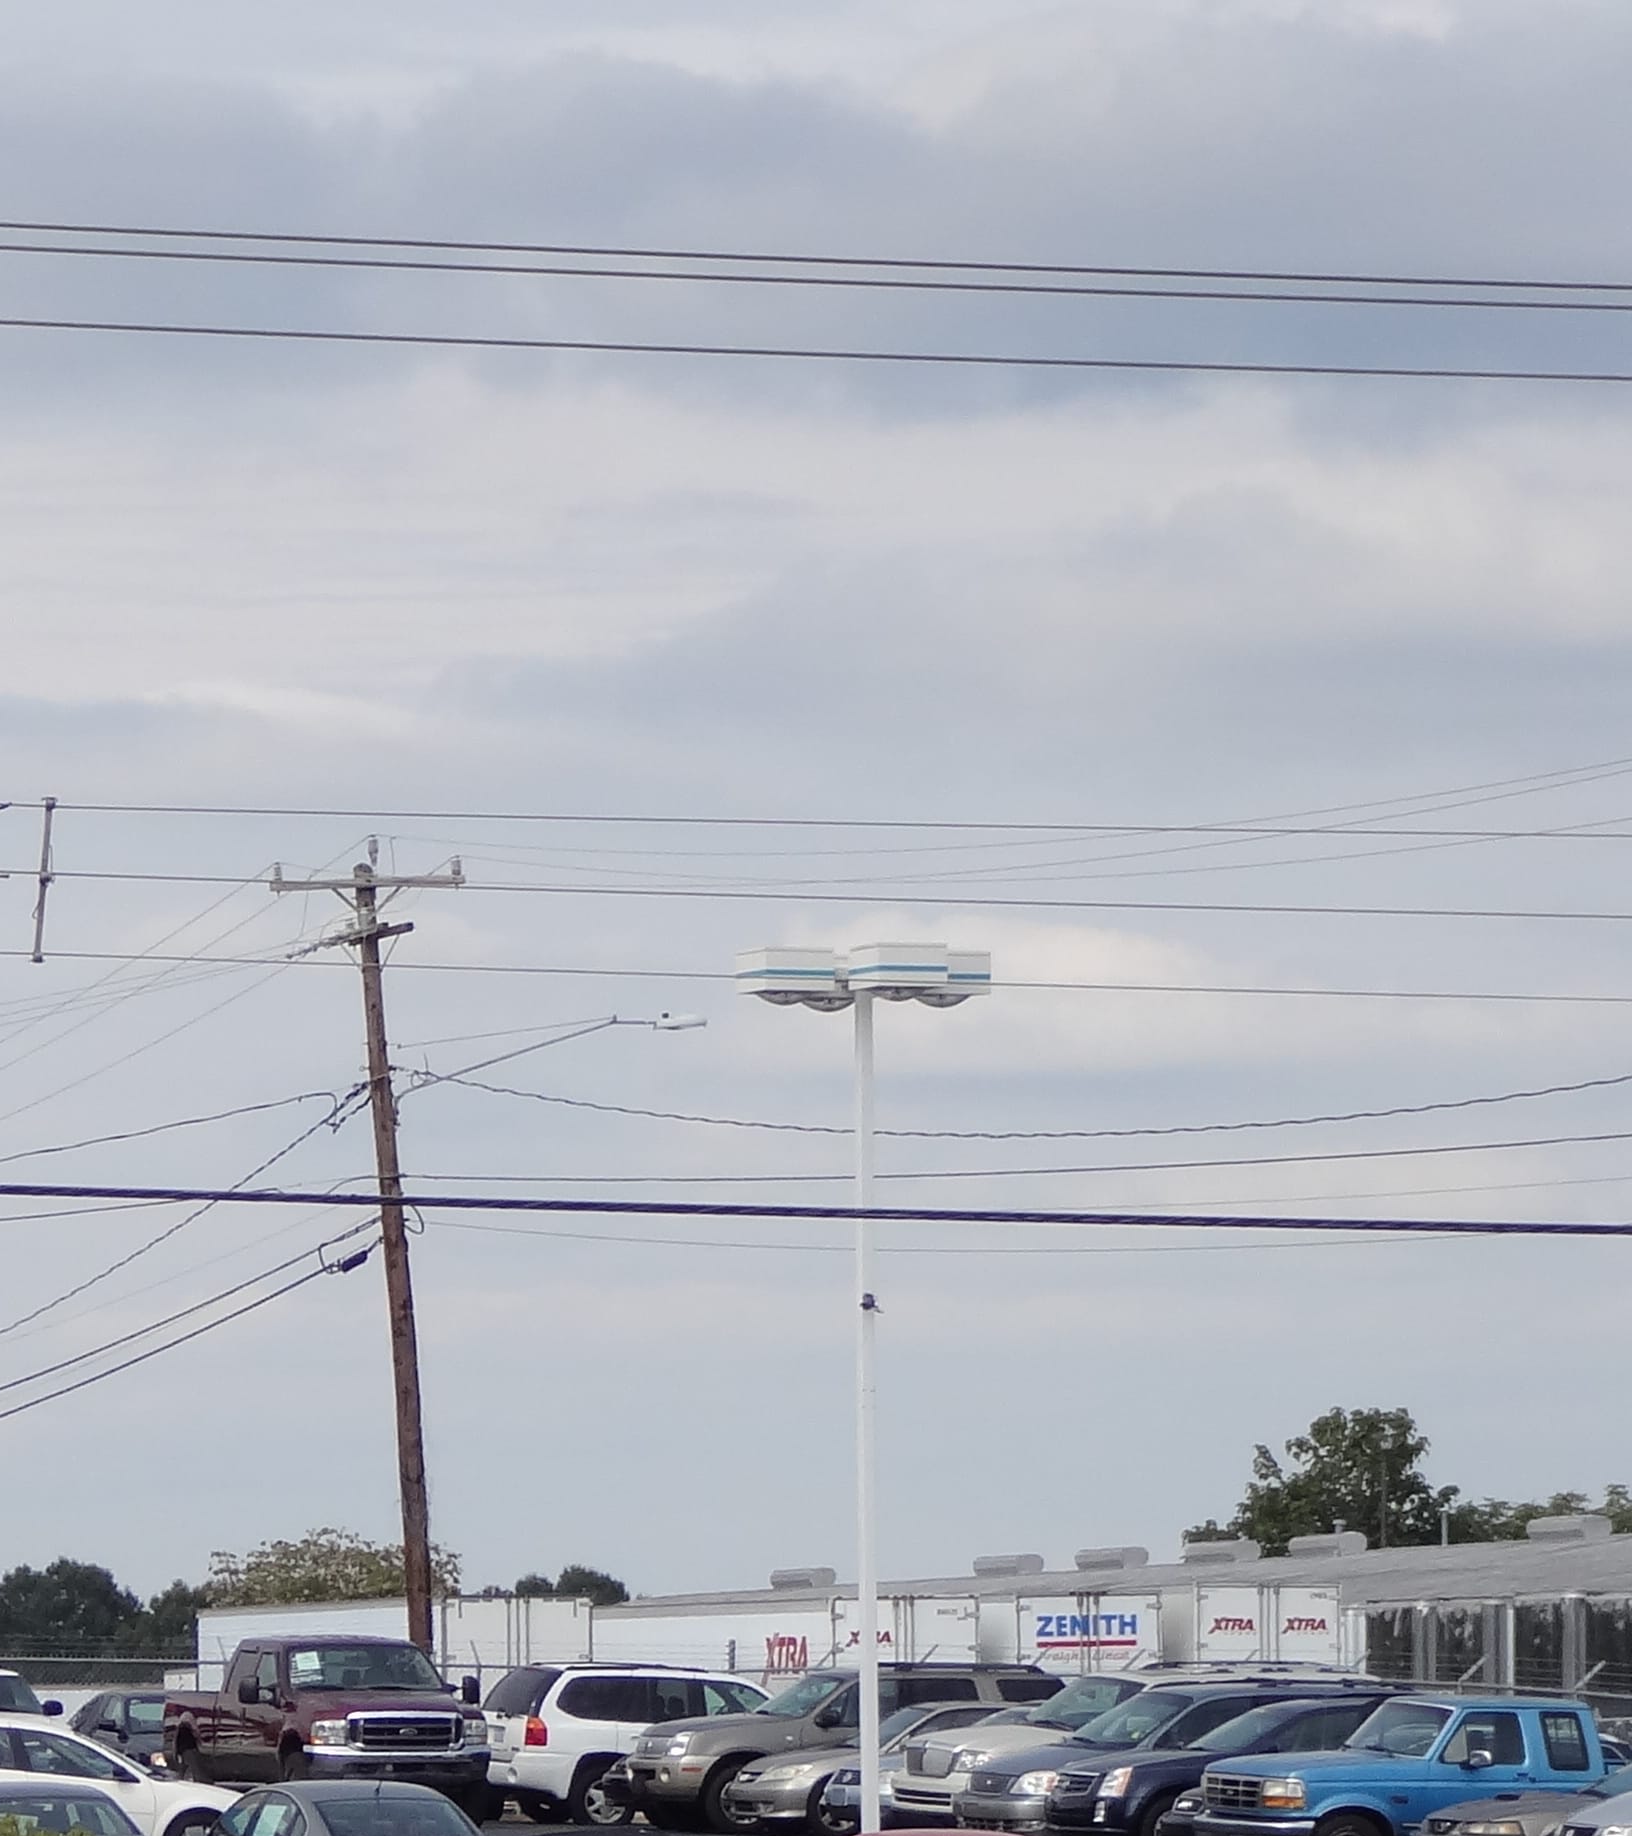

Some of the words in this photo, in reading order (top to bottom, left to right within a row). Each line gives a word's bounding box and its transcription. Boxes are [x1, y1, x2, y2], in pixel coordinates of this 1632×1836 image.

[1036, 1614, 1137, 1637] ZENITH
[1208, 1617, 1255, 1634] XTRA
[1282, 1617, 1328, 1634] XTRA
